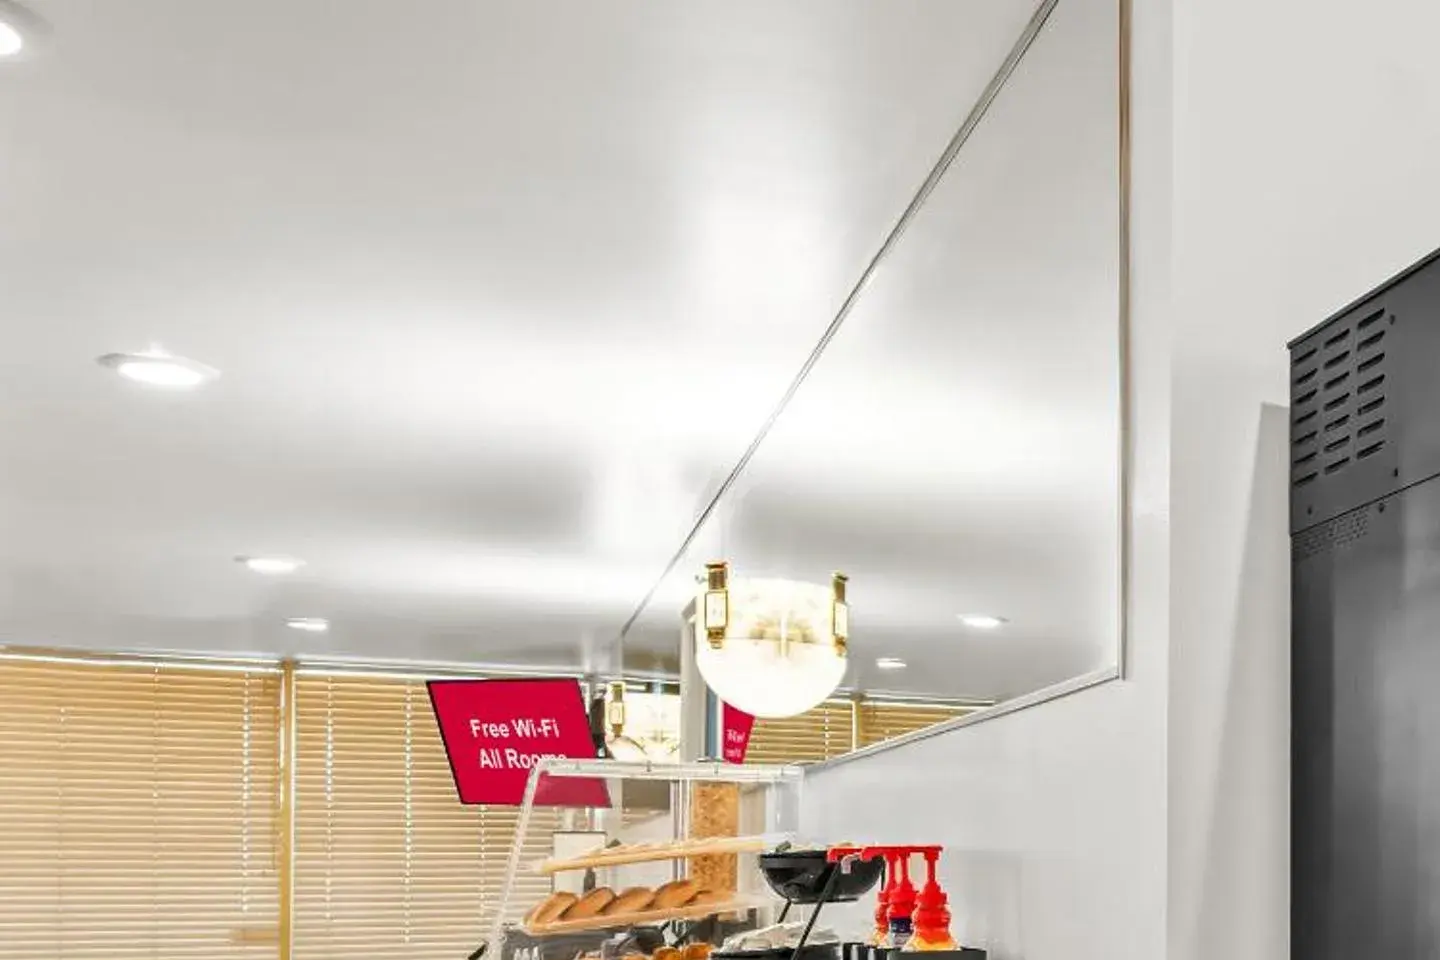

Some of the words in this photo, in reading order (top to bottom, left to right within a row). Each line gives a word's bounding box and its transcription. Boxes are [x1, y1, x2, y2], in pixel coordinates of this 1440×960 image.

[469, 719, 510, 738] Free
[511, 718, 560, 738] Wi-Fi
[480, 748, 503, 769] All
